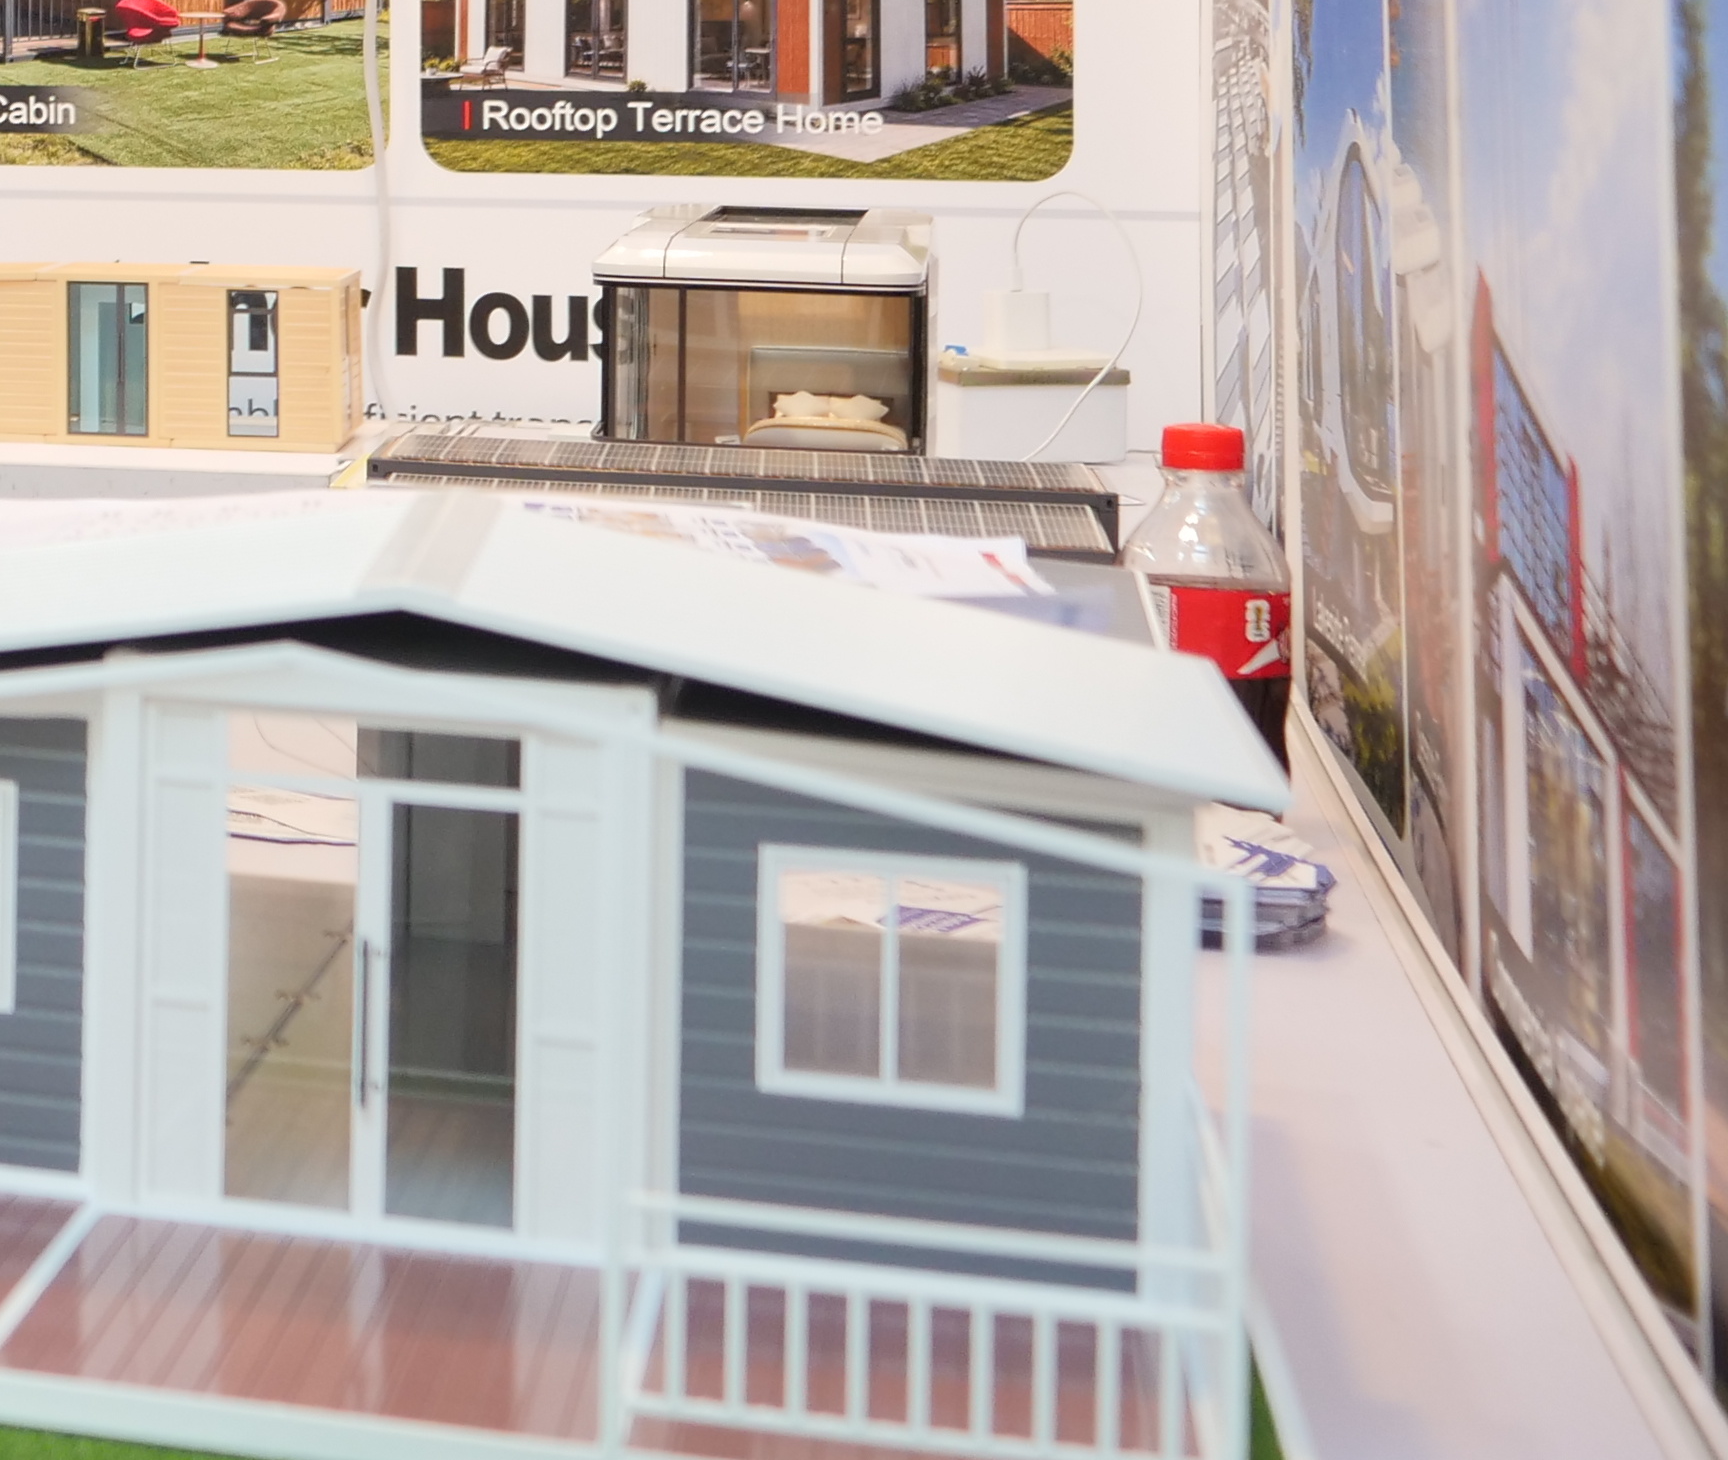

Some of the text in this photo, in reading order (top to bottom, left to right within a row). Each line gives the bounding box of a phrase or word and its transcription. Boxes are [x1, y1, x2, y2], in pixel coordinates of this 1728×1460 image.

[481, 101, 883, 138] Rooftop Terrace Home
[395, 266, 604, 362] Hou
